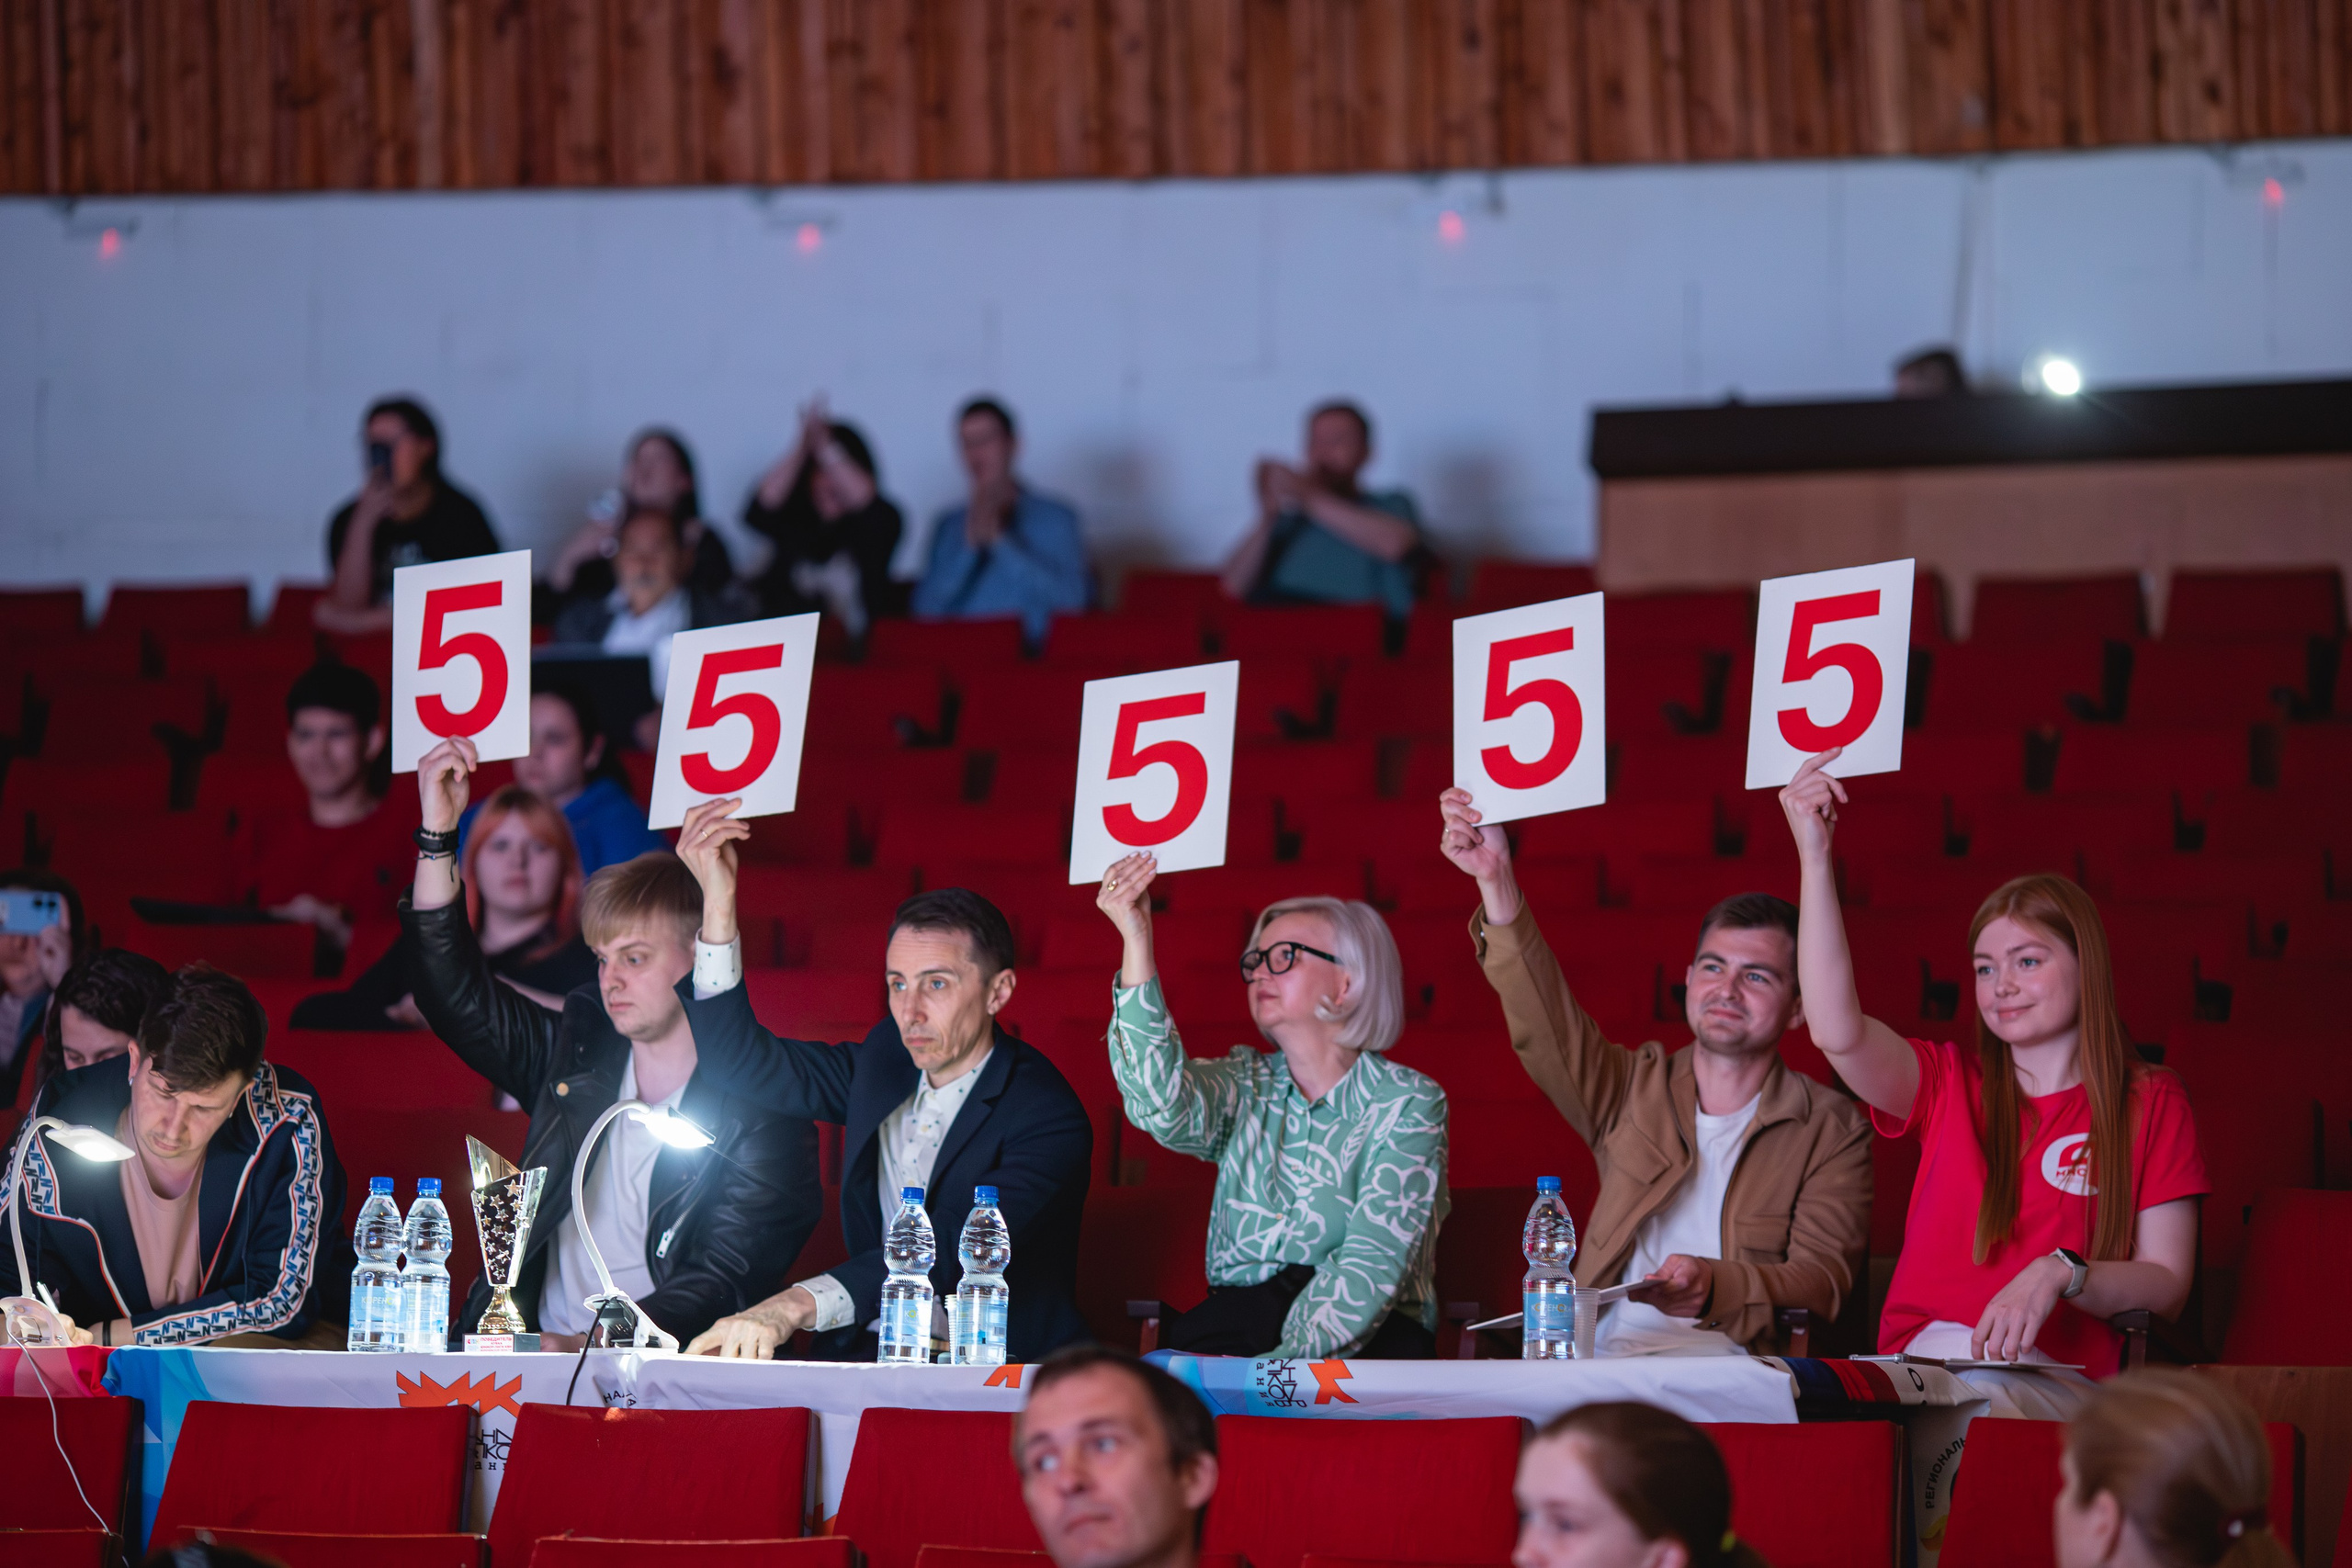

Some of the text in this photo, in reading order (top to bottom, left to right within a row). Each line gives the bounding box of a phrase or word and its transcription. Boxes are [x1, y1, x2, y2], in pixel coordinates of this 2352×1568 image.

[415, 580, 509, 739] 5
[680, 643, 782, 795] 5
[1481, 626, 1584, 790] 5
[1777, 589, 1883, 753] 5
[1102, 691, 1208, 848] 5
